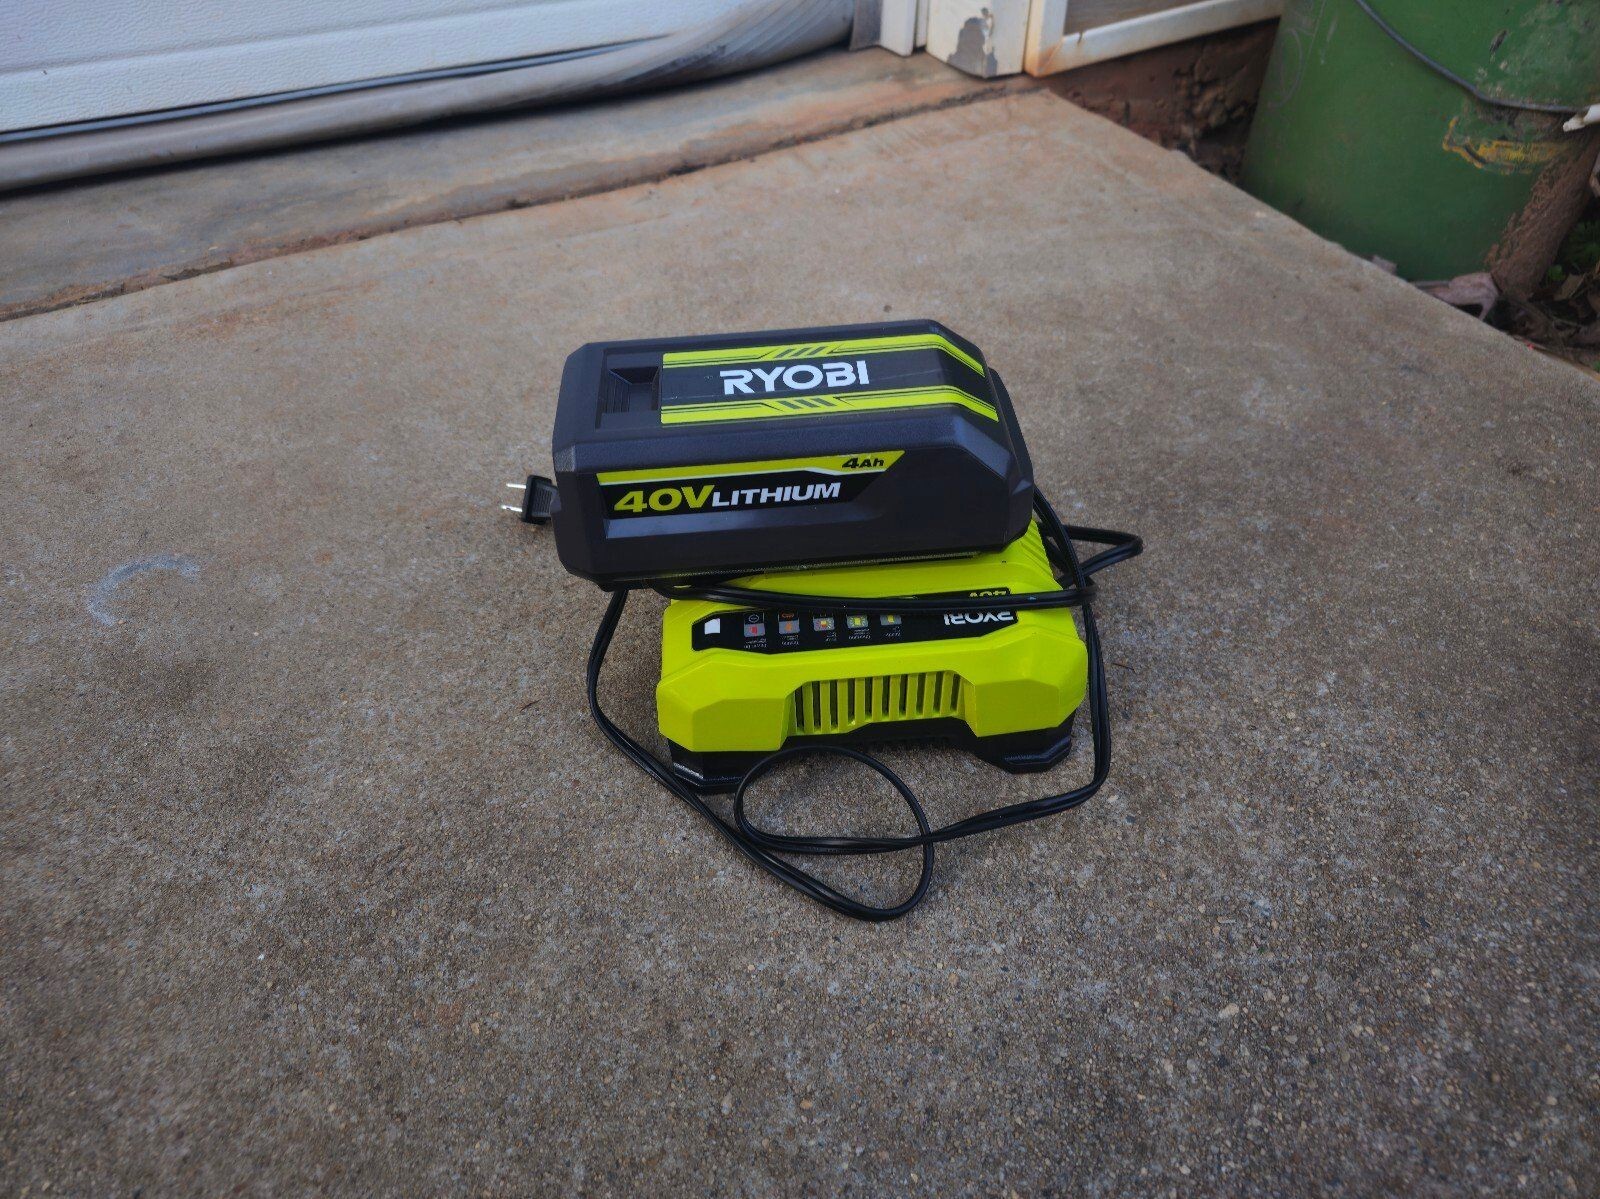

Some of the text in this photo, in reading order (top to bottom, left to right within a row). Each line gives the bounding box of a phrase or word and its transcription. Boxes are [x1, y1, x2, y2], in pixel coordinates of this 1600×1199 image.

[719, 360, 870, 395] RYOBI
[841, 457, 885, 469] 4Ah
[613, 482, 842, 513] 40V LITHIUM
